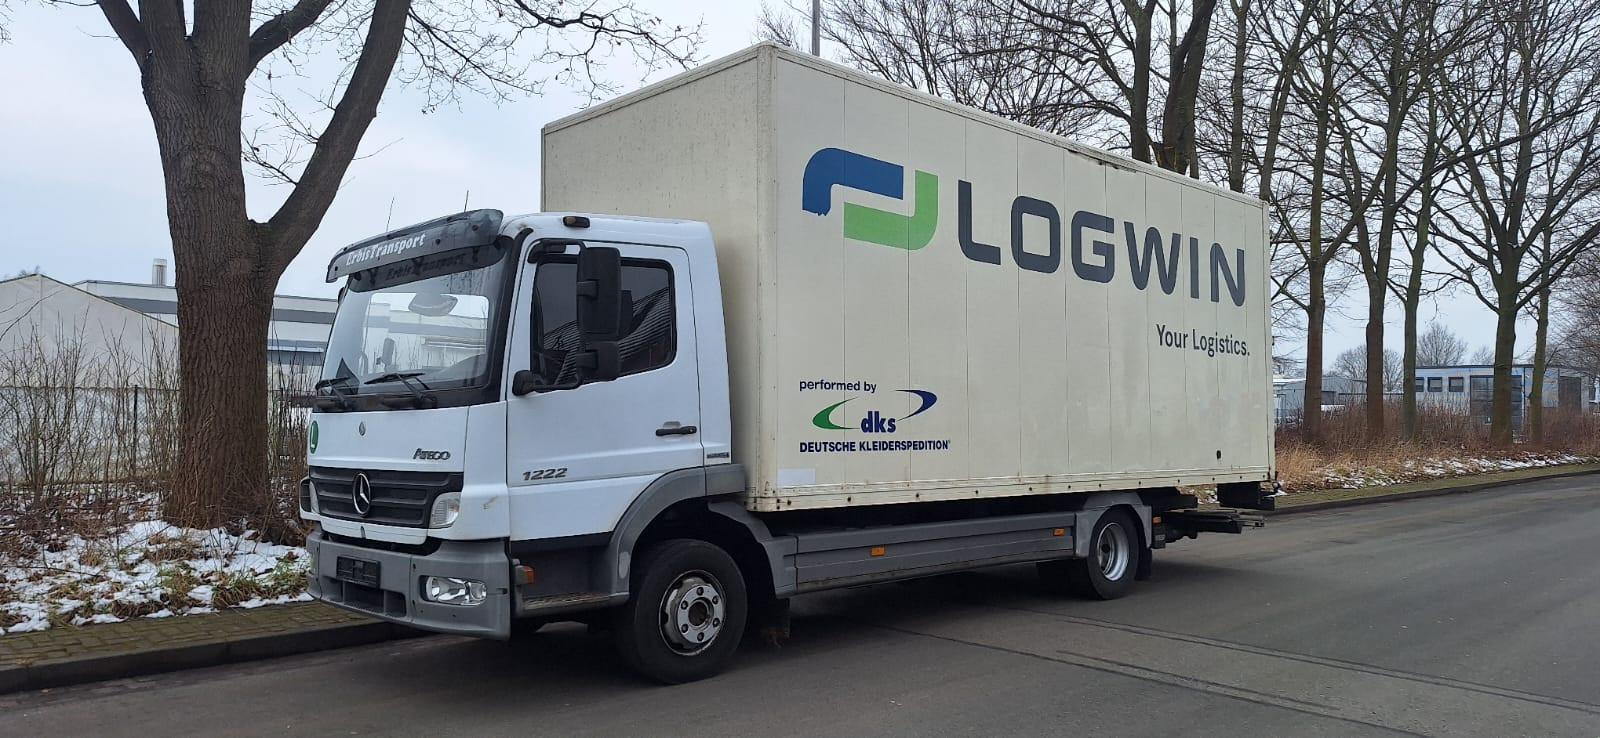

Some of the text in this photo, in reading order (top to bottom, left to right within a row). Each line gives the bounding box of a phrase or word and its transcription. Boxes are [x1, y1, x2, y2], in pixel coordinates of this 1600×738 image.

[957, 179, 1246, 307] LOGWIN
[1156, 324, 1251, 357] Your Logistics.
[799, 379, 877, 393] performed by
[860, 410, 897, 433] dks
[799, 441, 857, 453] DEUTSCHE
[522, 467, 568, 481] 1222
